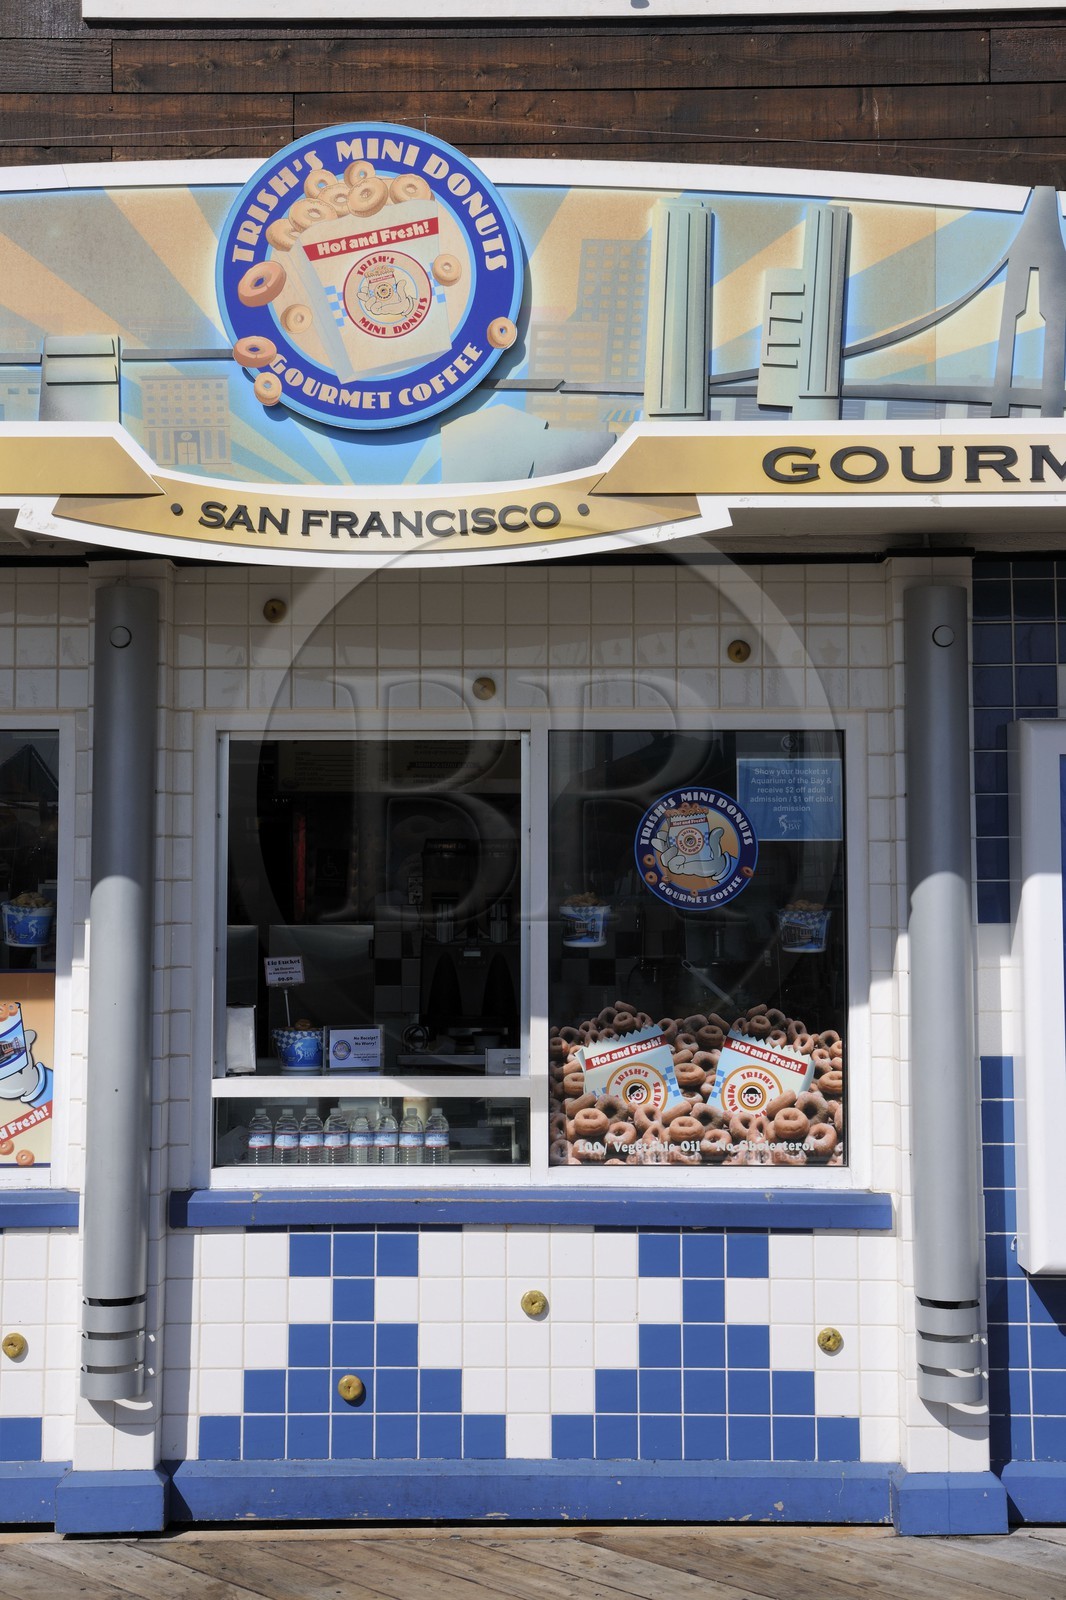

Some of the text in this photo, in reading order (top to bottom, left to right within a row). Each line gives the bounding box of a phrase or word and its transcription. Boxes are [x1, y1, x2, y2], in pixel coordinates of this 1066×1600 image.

[231, 137, 508, 272] TRISH'S MINI DONUTS
[316, 220, 430, 256] Hot and Fresh!
[356, 255, 395, 276] TRISH'S
[359, 297, 428, 335] MINI DONUTS
[269, 342, 483, 409] GOURMET COFFEE
[199, 501, 562, 539] SAN FRANCISCO
[750, 777, 786, 786] Aquarium
[810, 777, 825, 786] Bay
[776, 769, 793, 777] your
[785, 786, 793, 794] $2
[793, 795, 801, 803] $1
[640, 791, 754, 845] TRISH'S MINI DONUTS
[658, 875, 743, 904] GOURMET COFFEE
[591, 1036, 662, 1066] Hot and Fresh!
[730, 1040, 802, 1072] Hot and Fresh!
[614, 1068, 650, 1086] TRISH'S
[740, 1071, 775, 1090] TRISH'S
[727, 1084, 739, 1112] MINI
[7, 1105, 49, 1135] Fresh!
[613, 1141, 675, 1154] Vegetble
[680, 1141, 701, 1151] Oil
[716, 1142, 734, 1151] No
